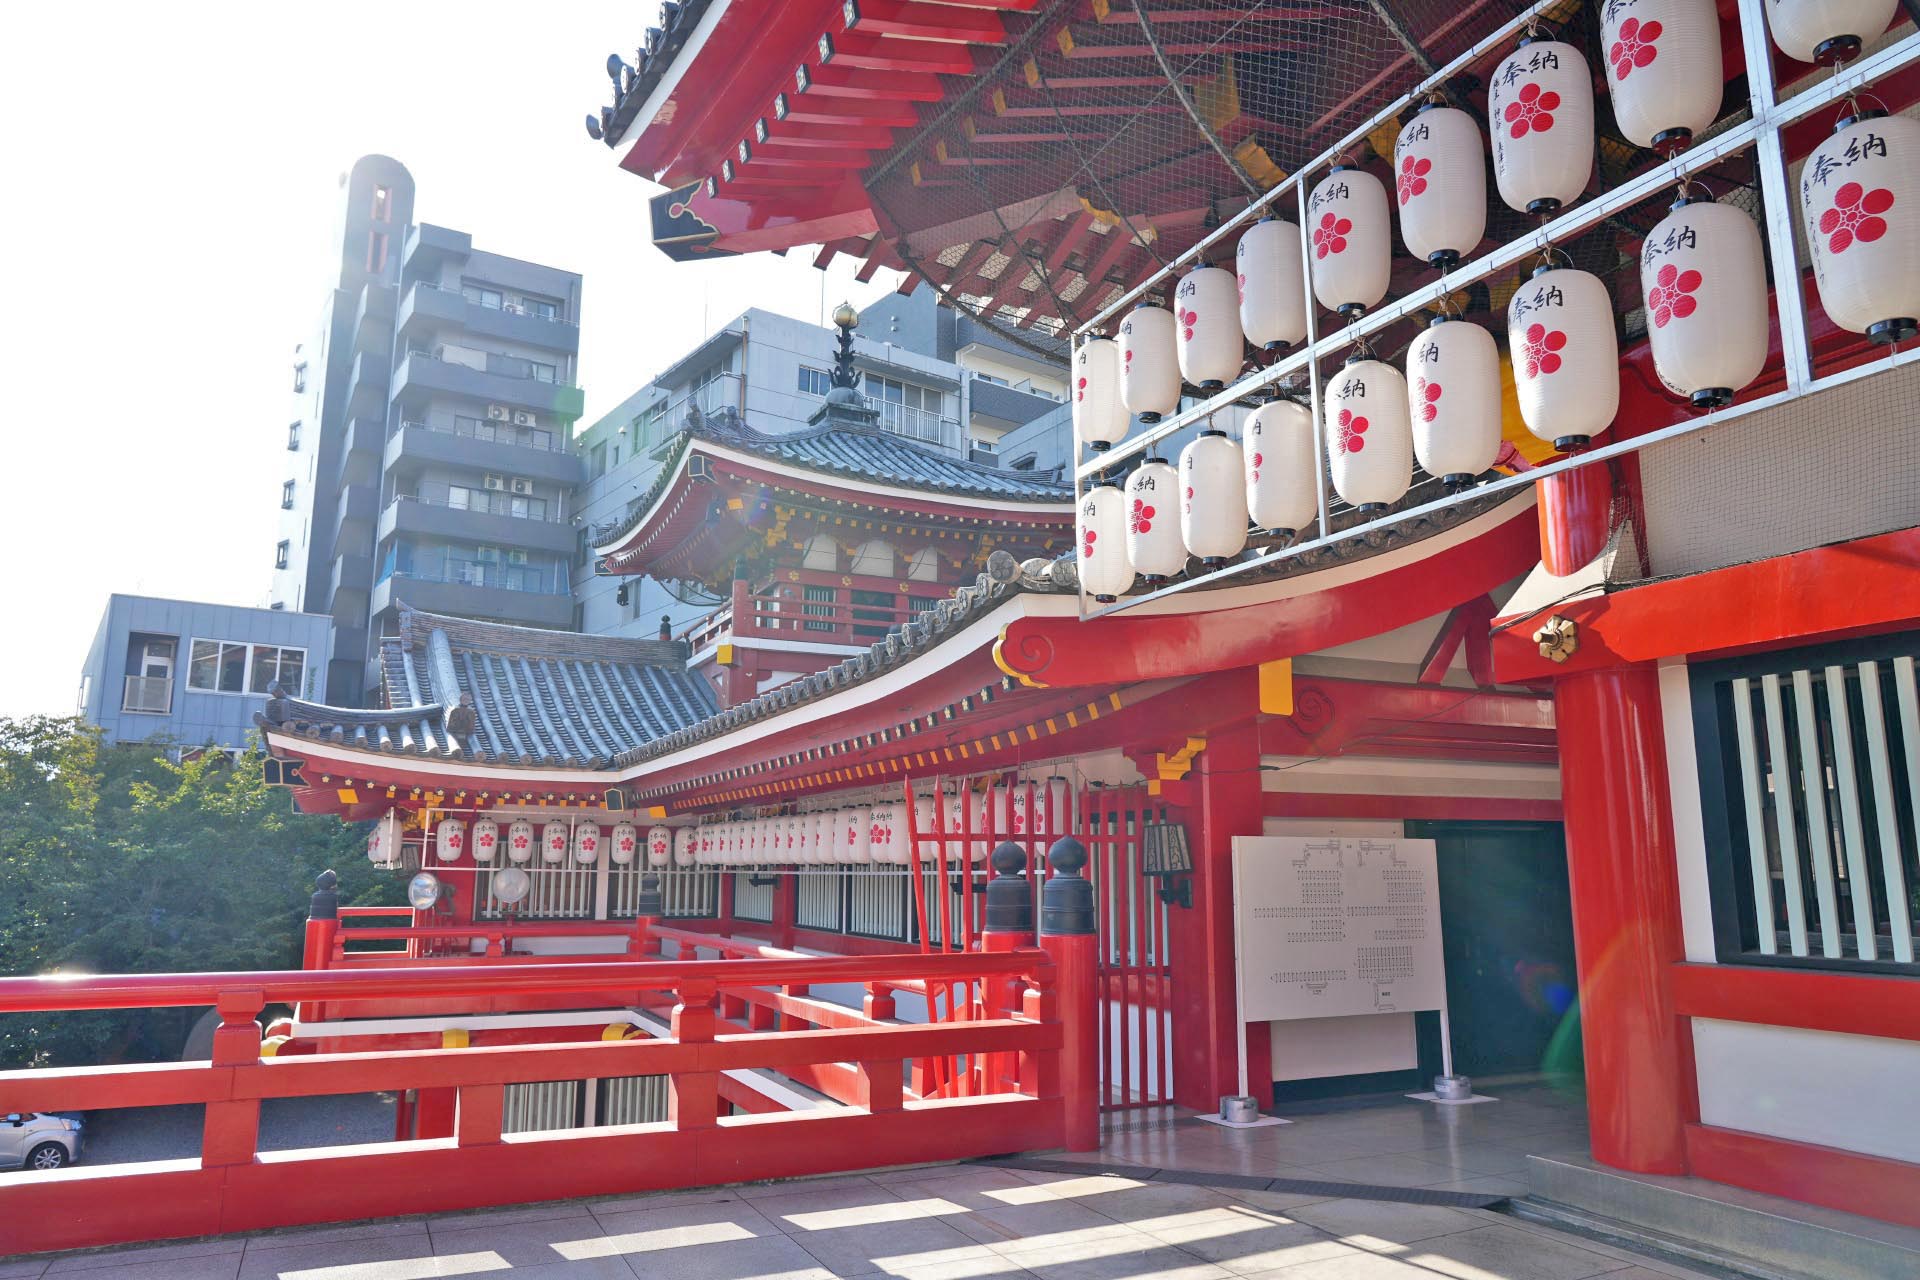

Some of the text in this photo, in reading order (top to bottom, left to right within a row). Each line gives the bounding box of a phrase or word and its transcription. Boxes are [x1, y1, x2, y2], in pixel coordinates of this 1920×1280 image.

[1502, 51, 1559, 88] 奉納
[1812, 133, 1888, 187] 奉納
[1311, 182, 1349, 213] 奉納
[1644, 226, 1697, 272] 奉納
[1513, 285, 1564, 322] 奉納
